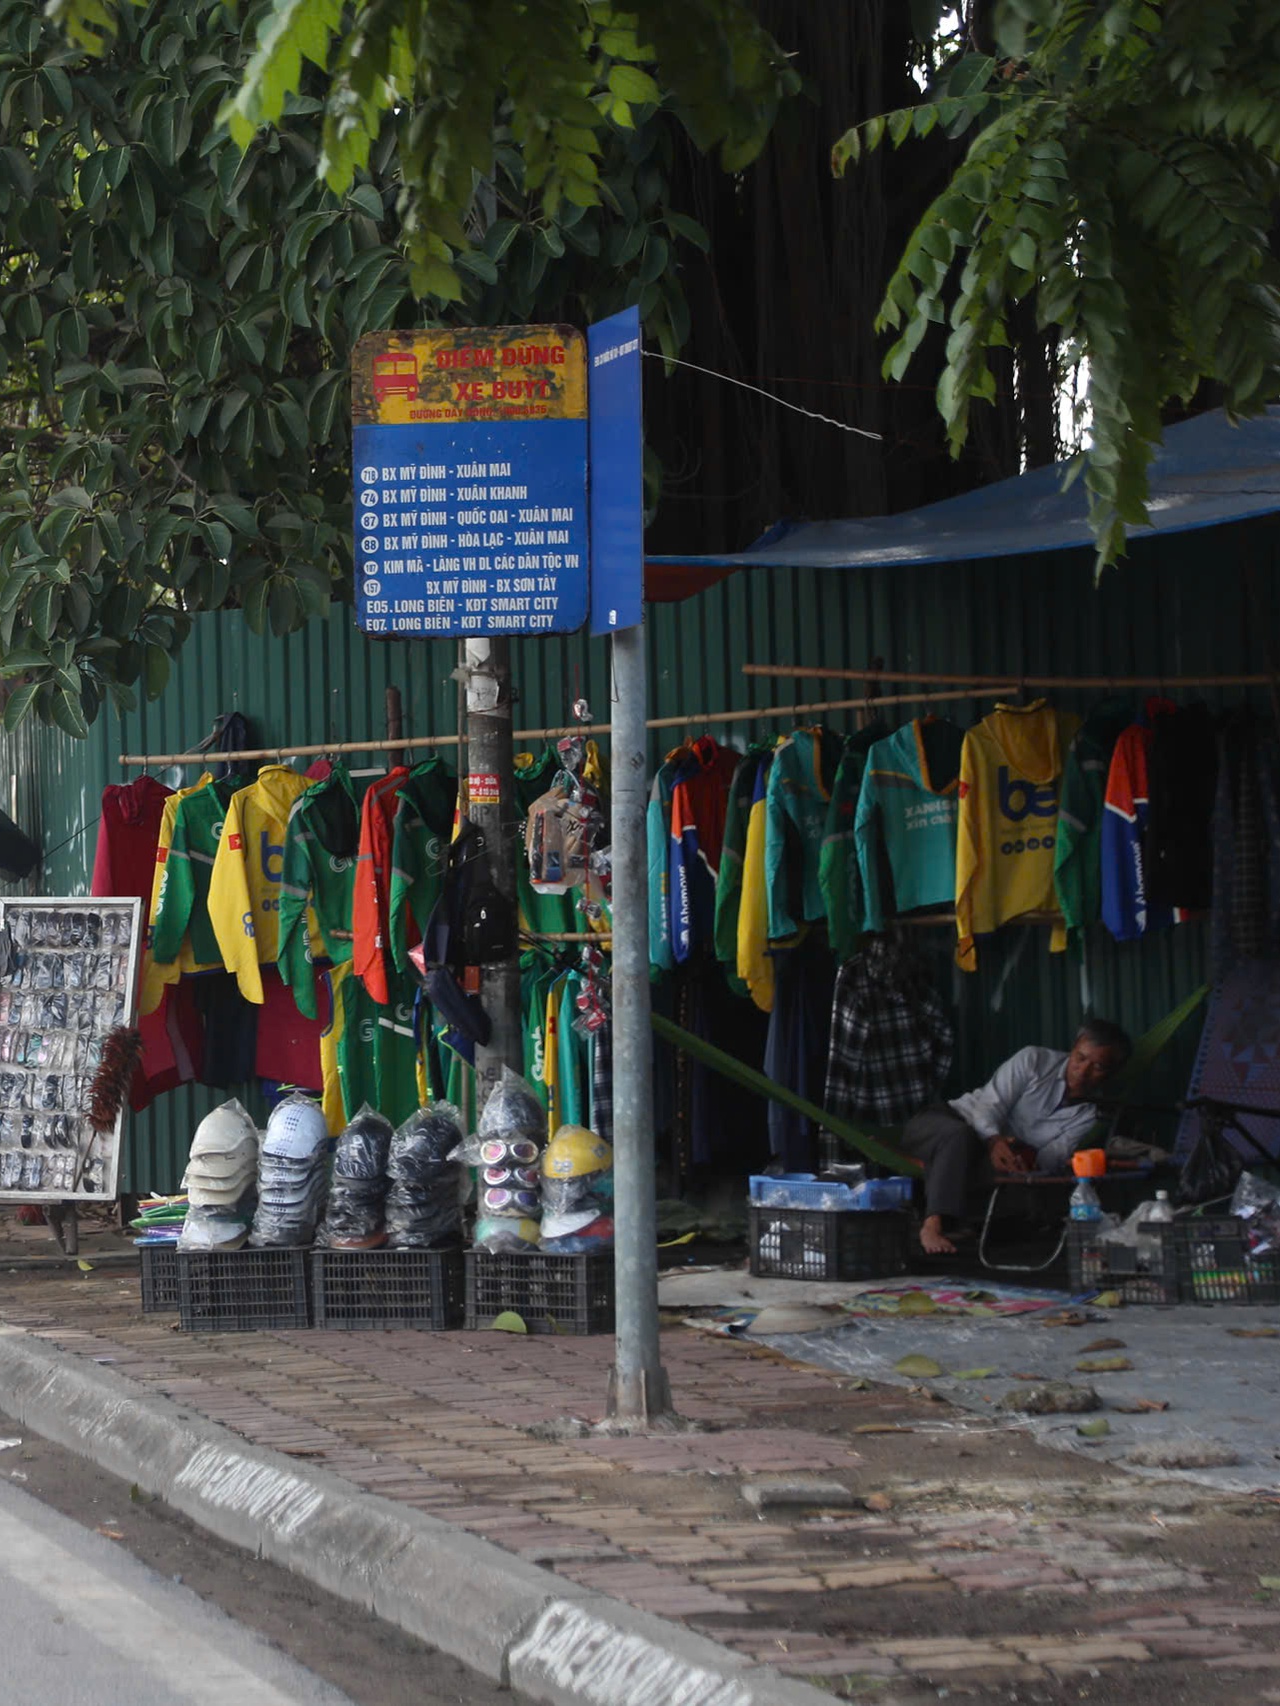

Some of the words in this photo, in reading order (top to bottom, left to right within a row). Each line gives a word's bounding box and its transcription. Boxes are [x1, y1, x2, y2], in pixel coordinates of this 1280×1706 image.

[502, 341, 565, 367] DỪNG
[456, 382, 484, 401] XE
[382, 467, 397, 481] BX
[400, 463, 417, 481] MỸ
[420, 463, 446, 480] ĐÌNH
[456, 461, 486, 479] XUÂN
[489, 463, 511, 477] MAI
[382, 490, 397, 504] BX
[400, 485, 417, 503] MỸ
[420, 485, 447, 502] ĐÌNH
[457, 484, 487, 501] XUÂN
[490, 486, 528, 500] KHANH
[383, 513, 398, 527] BX
[401, 509, 418, 527] MỸ
[420, 508, 447, 526] ĐÌNH
[457, 506, 486, 526] QUỐC
[489, 510, 508, 524] OAI
[518, 505, 549, 523] XUÂN
[551, 507, 573, 522] MAI
[384, 536, 399, 550] BX
[401, 532, 419, 550] MỸ
[421, 532, 448, 549] ĐÌNH
[458, 531, 480, 548] HÒA
[483, 532, 504, 550] LẠC
[514, 528, 544, 546] XUÂN
[547, 530, 569, 545] MAI
[383, 560, 404, 574] KIM
[433, 554, 460, 572] LÀNG
[463, 557, 476, 571] VH
[479, 556, 492, 570] DL
[494, 552, 515, 570] CÁC
[518, 552, 540, 569] DÂN
[542, 551, 562, 571] TỘC
[564, 554, 579, 568] VN
[426, 581, 441, 594] BX
[443, 577, 459, 594] MỸ
[461, 577, 487, 593] ĐÌNH
[496, 579, 511, 592] BX
[513, 577, 535, 592] SƠN
[537, 574, 557, 591] TÂY
[394, 599, 425, 613] LONG
[427, 596, 455, 612] BIÊN
[465, 598, 488, 612] KĐT
[490, 597, 531, 611] SMART
[533, 596, 559, 610] CITY
[392, 617, 422, 631] LONG
[424, 613, 451, 630] BIÊN
[461, 615, 483, 629] KĐT
[487, 615, 527, 629] SMART
[529, 614, 554, 628] CITY
[999, 766, 1059, 821] be
[679, 864, 689, 925] Ahamove
